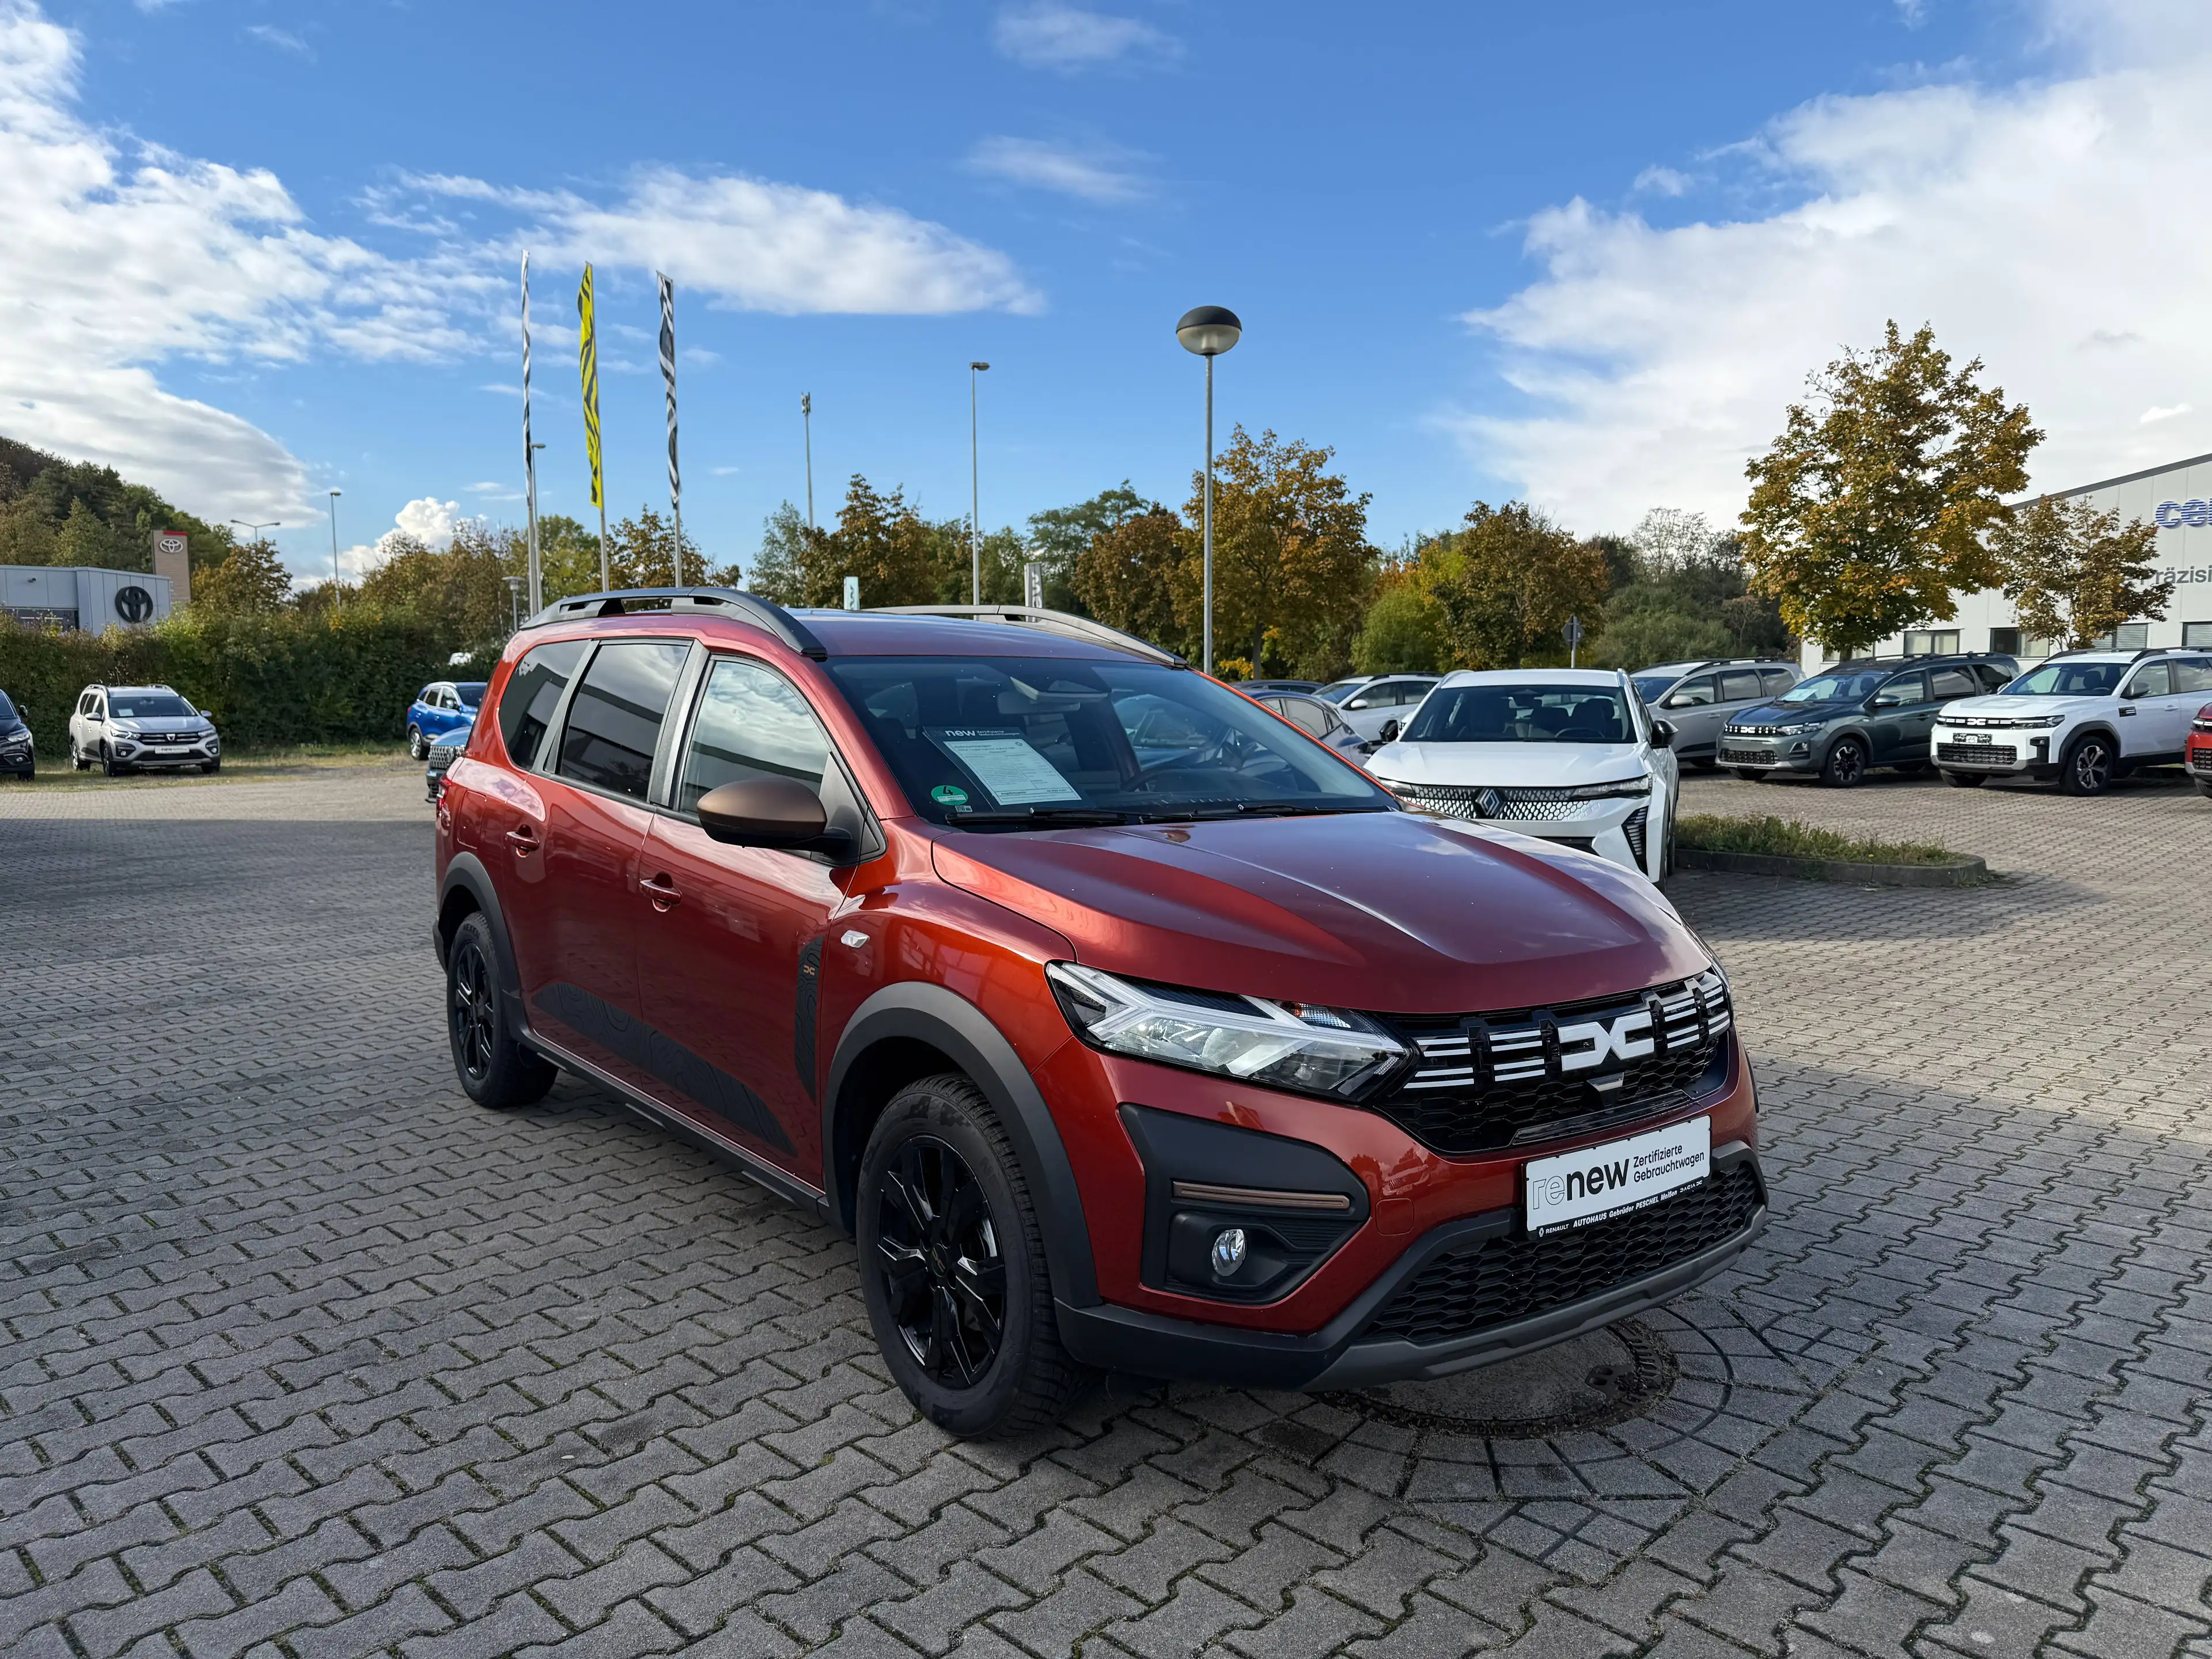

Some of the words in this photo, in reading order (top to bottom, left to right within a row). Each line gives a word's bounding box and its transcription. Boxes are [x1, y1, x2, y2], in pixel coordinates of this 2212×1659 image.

[2139, 565, 2212, 585] räzisi
[1633, 1145, 1683, 1168] Zertifizierte
[1634, 1152, 1705, 1183] Gebrauchtwagen
[1533, 1158, 1630, 1210] renew
[1546, 1224, 1569, 1234] RENAULT
[1573, 1213, 1607, 1228] AUTOHAUS
[1609, 1206, 1634, 1218] Gebrüder
[1635, 1196, 1659, 1210] PESCHEL
[1661, 1190, 1677, 1201] Meißen
[1680, 1183, 1696, 1193] DACIA
